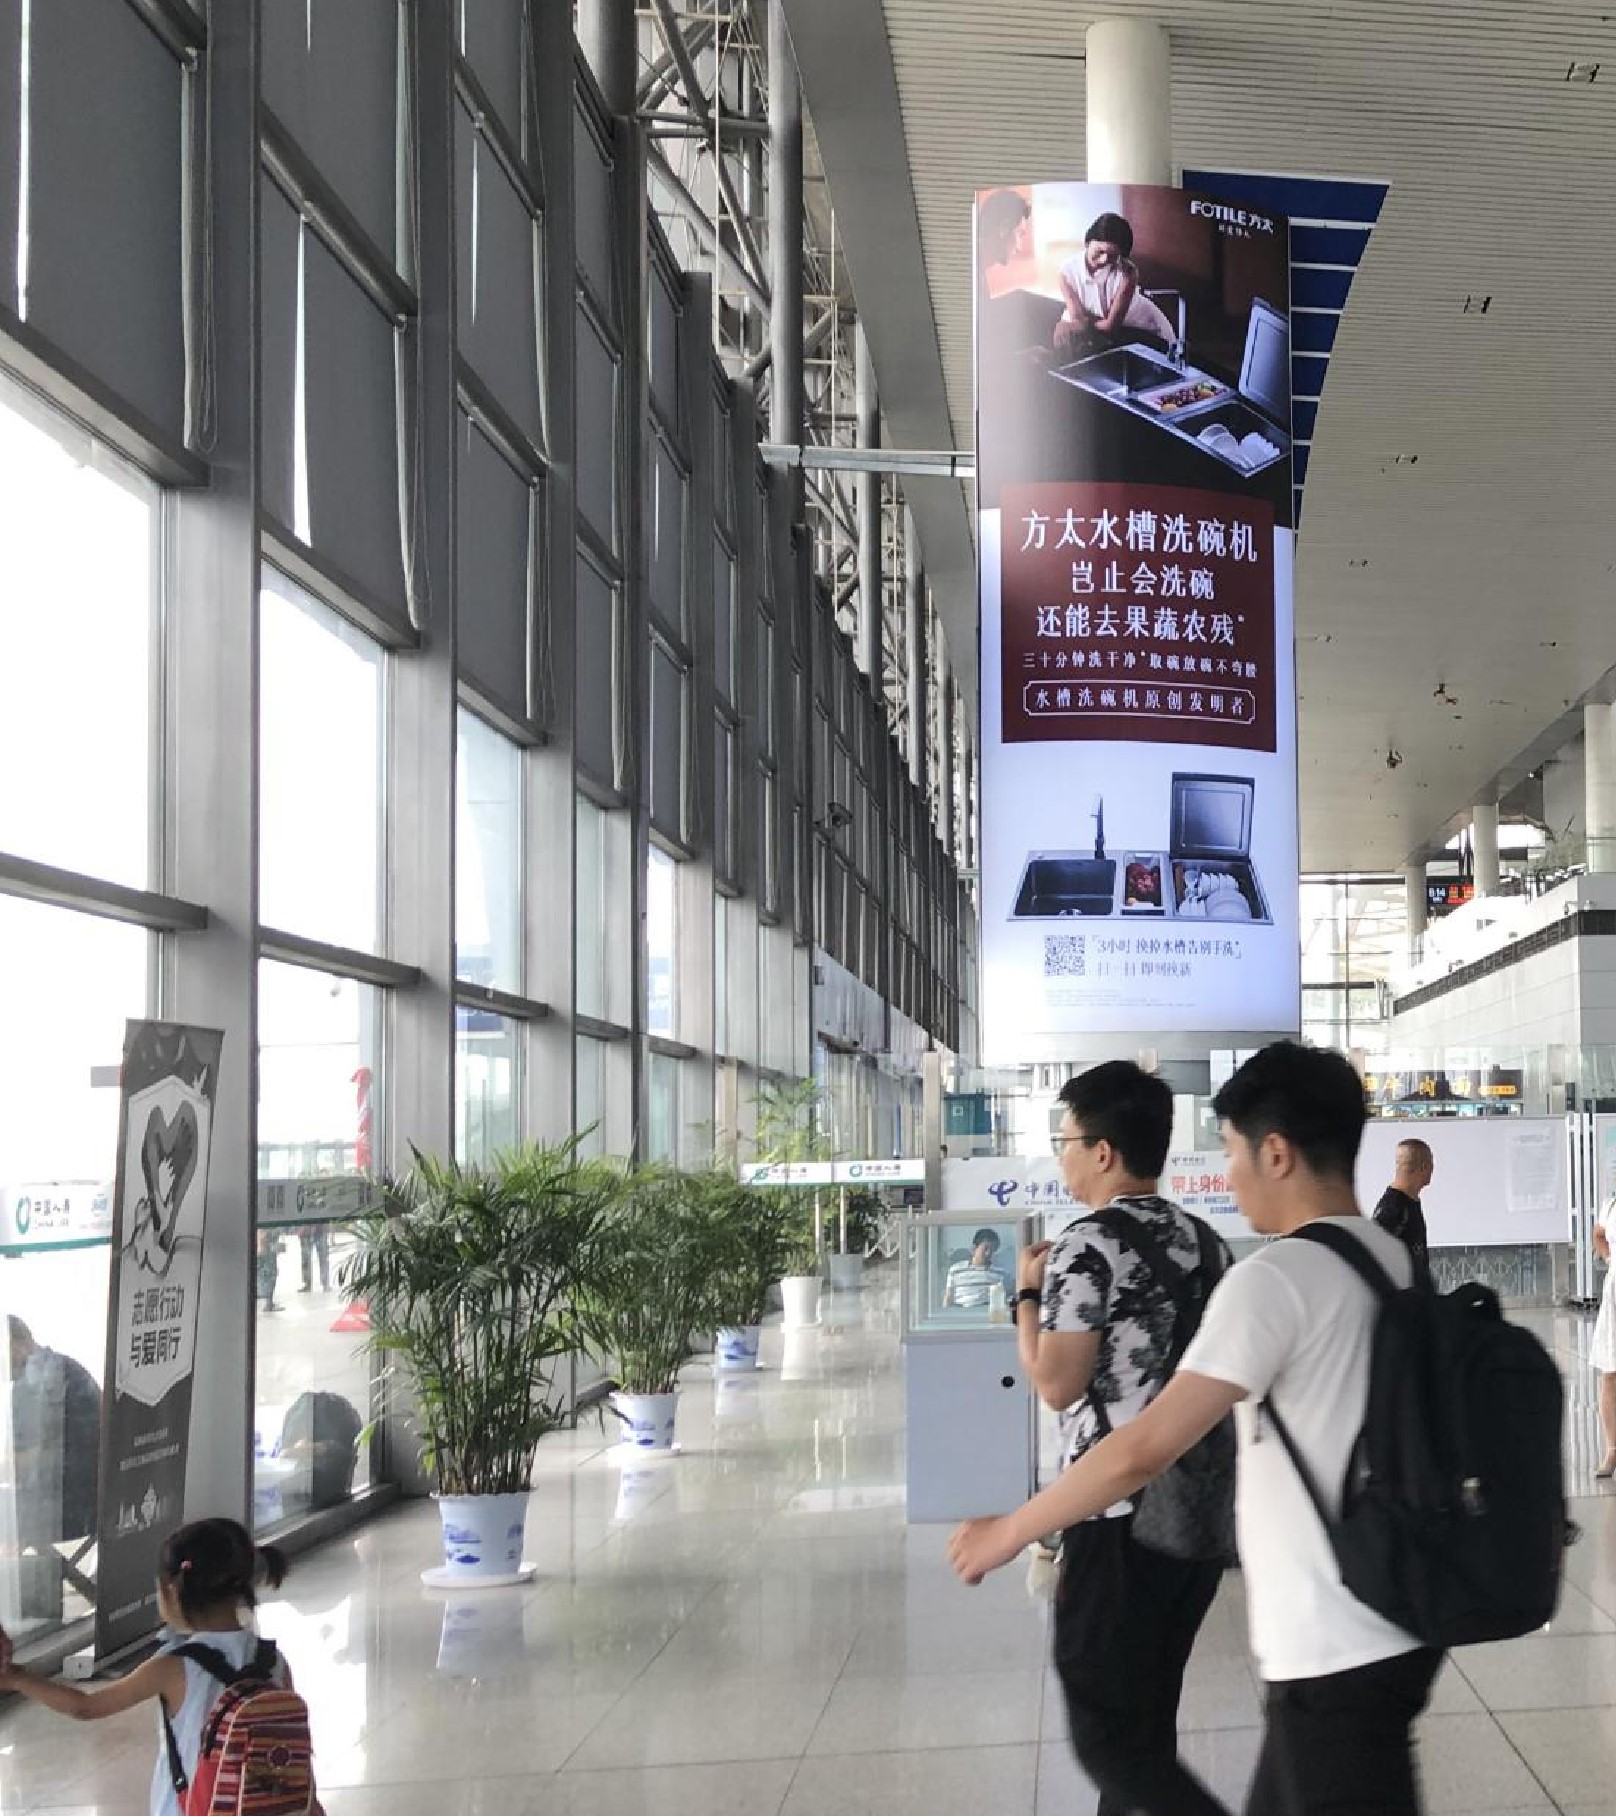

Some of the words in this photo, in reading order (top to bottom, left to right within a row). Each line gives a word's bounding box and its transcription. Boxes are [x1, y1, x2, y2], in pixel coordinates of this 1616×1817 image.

[1190, 200, 1247, 226] FOTILE
[1020, 508, 1258, 563] 方太水槽洗碗机
[1072, 560, 1215, 600] 岂止会洗碗
[1035, 687, 1245, 716] 水槽洗碗机原创发明者
[131, 1283, 184, 1326] 志愿行动
[129, 1325, 181, 1368] 与爱同行
